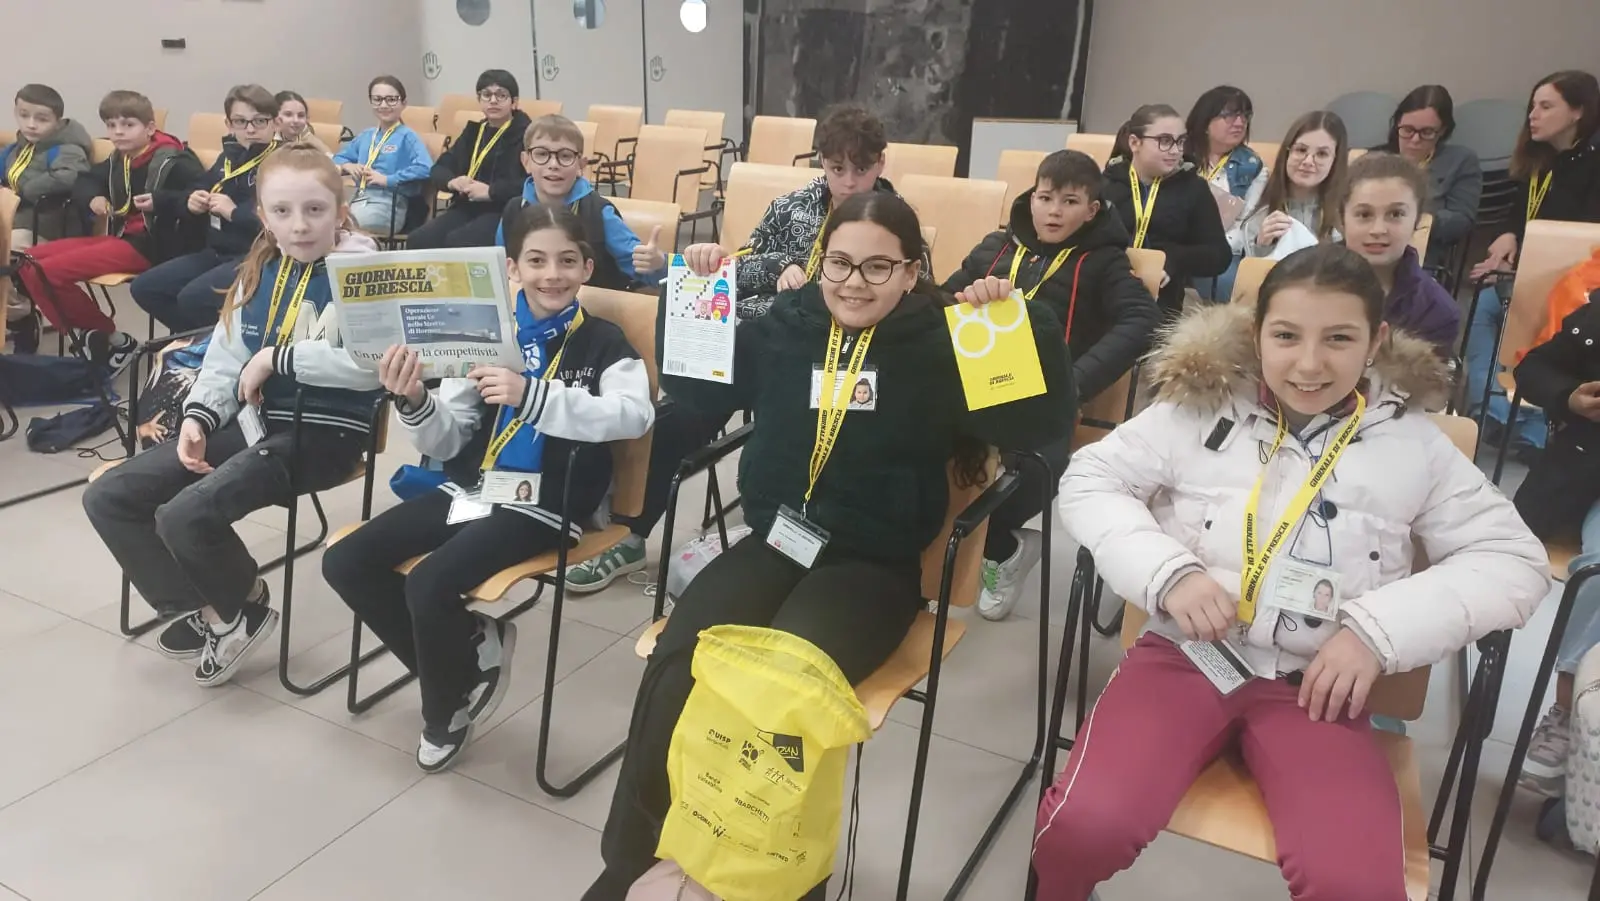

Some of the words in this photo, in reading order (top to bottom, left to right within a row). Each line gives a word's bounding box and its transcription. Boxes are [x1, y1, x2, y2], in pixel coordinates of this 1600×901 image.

[345, 268, 426, 284] GIORNALE
[343, 286, 361, 298] DI
[365, 281, 434, 296] BRESCIA
[422, 348, 432, 357] la
[434, 346, 498, 358] competitività
[1310, 452, 1336, 488] GIORNALE
[1332, 443, 1341, 454] DI
[1338, 415, 1360, 444] BRESCIA
[1246, 513, 1254, 554] GIORNALE
[1245, 563, 1264, 602] GIORNALE
[1261, 552, 1270, 564] DI
[1266, 521, 1290, 554] BRESCIA
[714, 732, 732, 744] UISP
